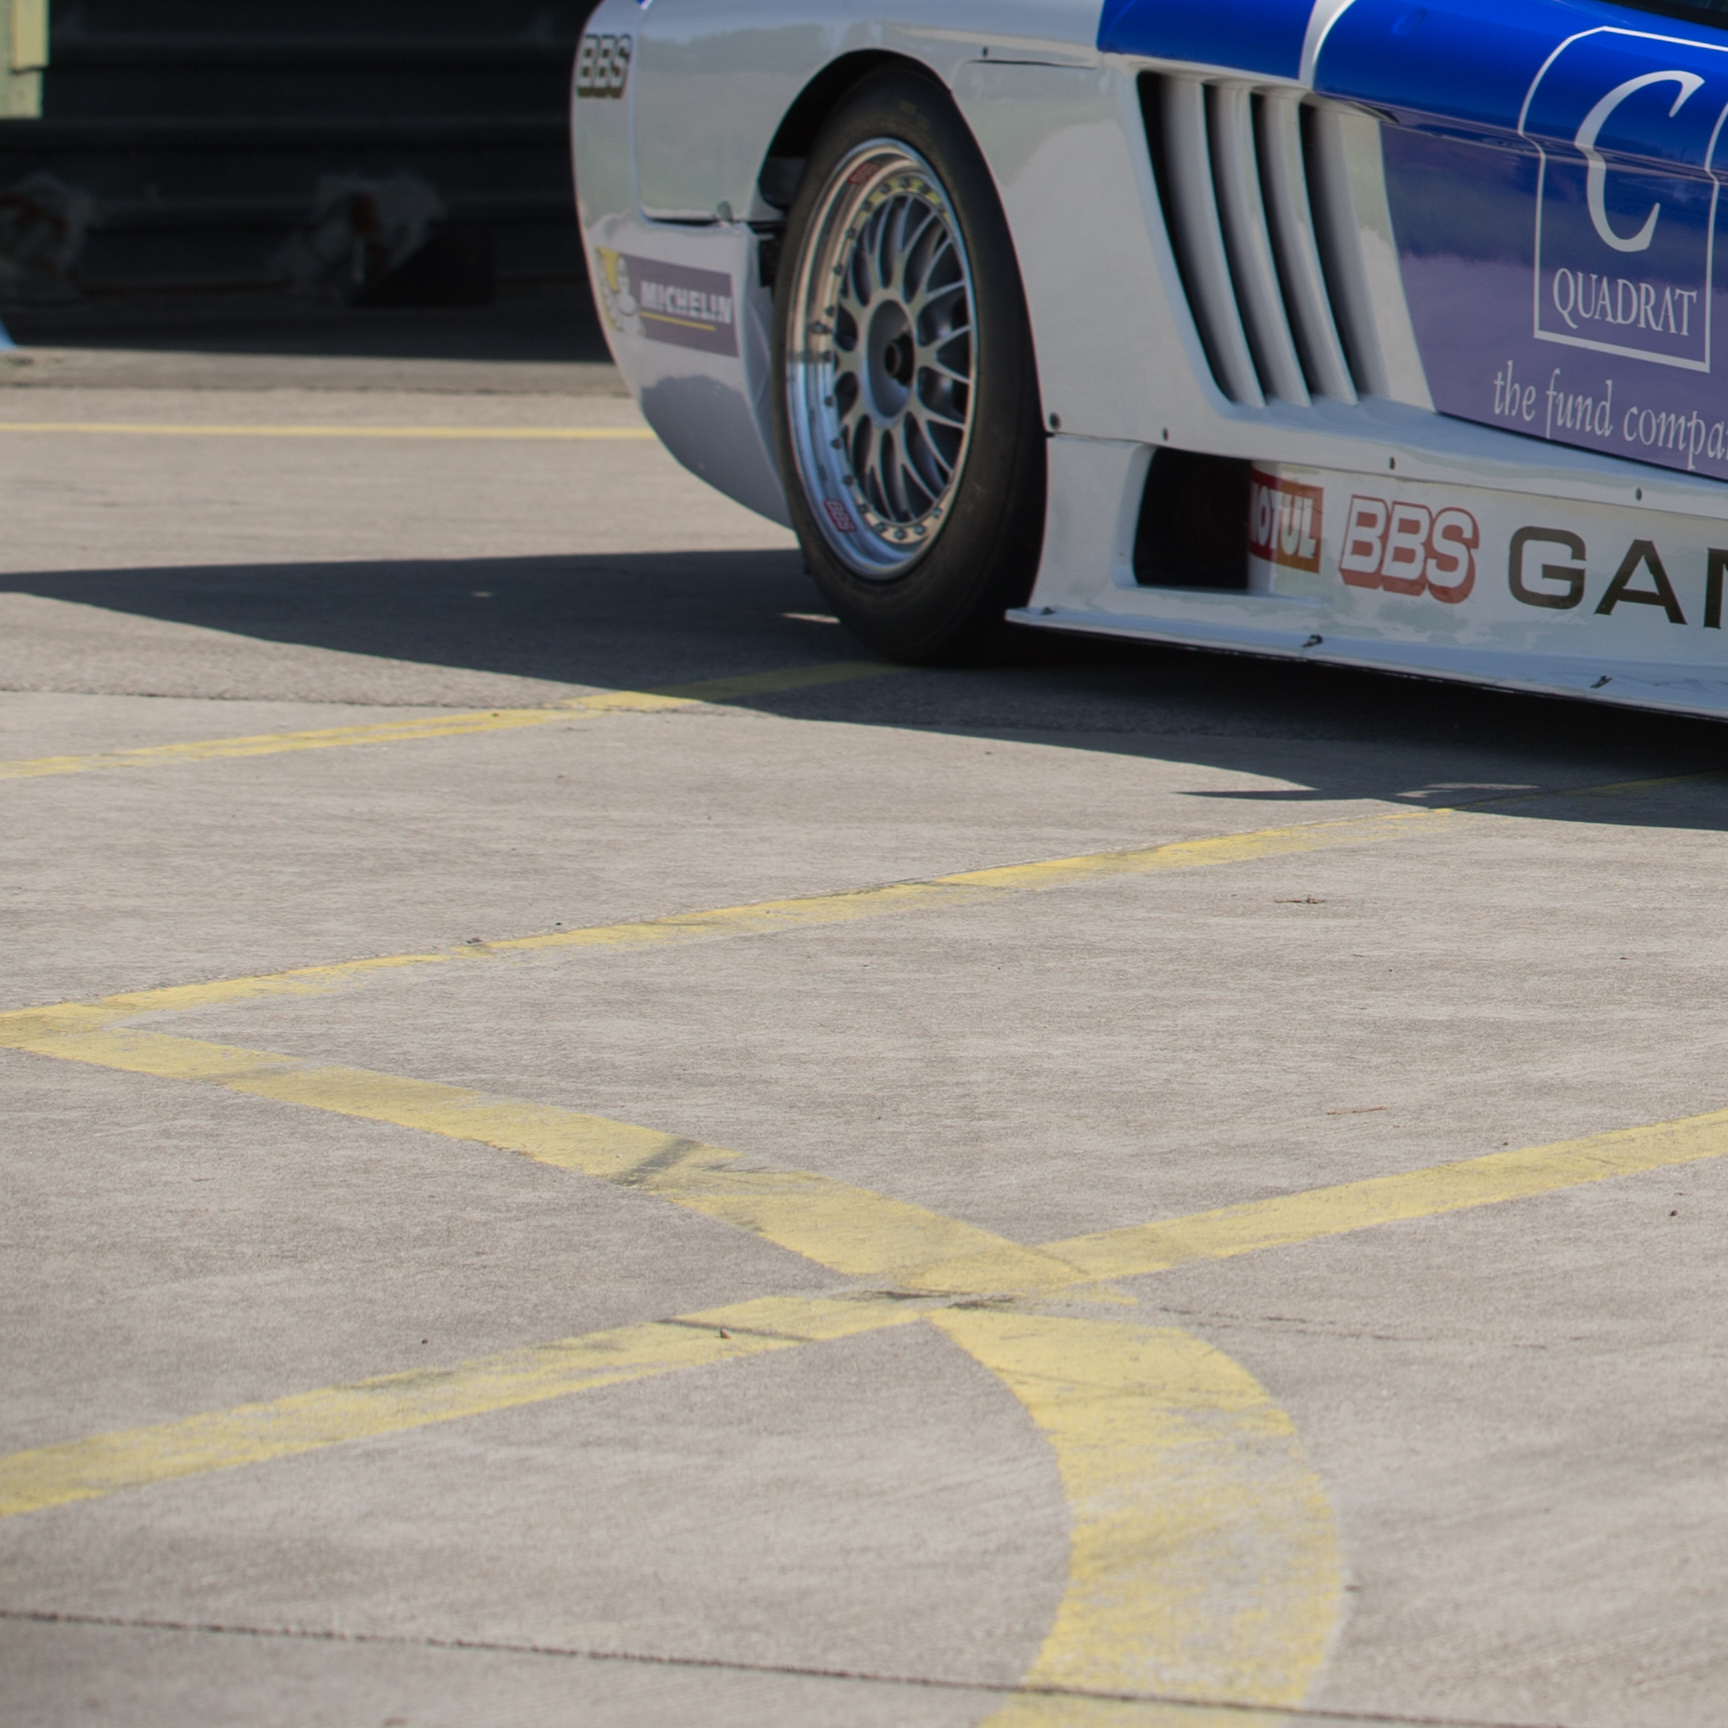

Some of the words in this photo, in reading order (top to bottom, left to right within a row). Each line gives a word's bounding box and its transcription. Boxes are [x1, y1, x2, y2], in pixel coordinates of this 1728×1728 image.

[576, 34, 634, 99] BBS
[1574, 70, 1706, 253] C
[640, 279, 733, 325] MICHELIN
[1552, 268, 1698, 337] QUADRAT
[1493, 360, 1537, 423] the
[1545, 368, 1614, 440] fund
[1338, 493, 1481, 605] BBS
